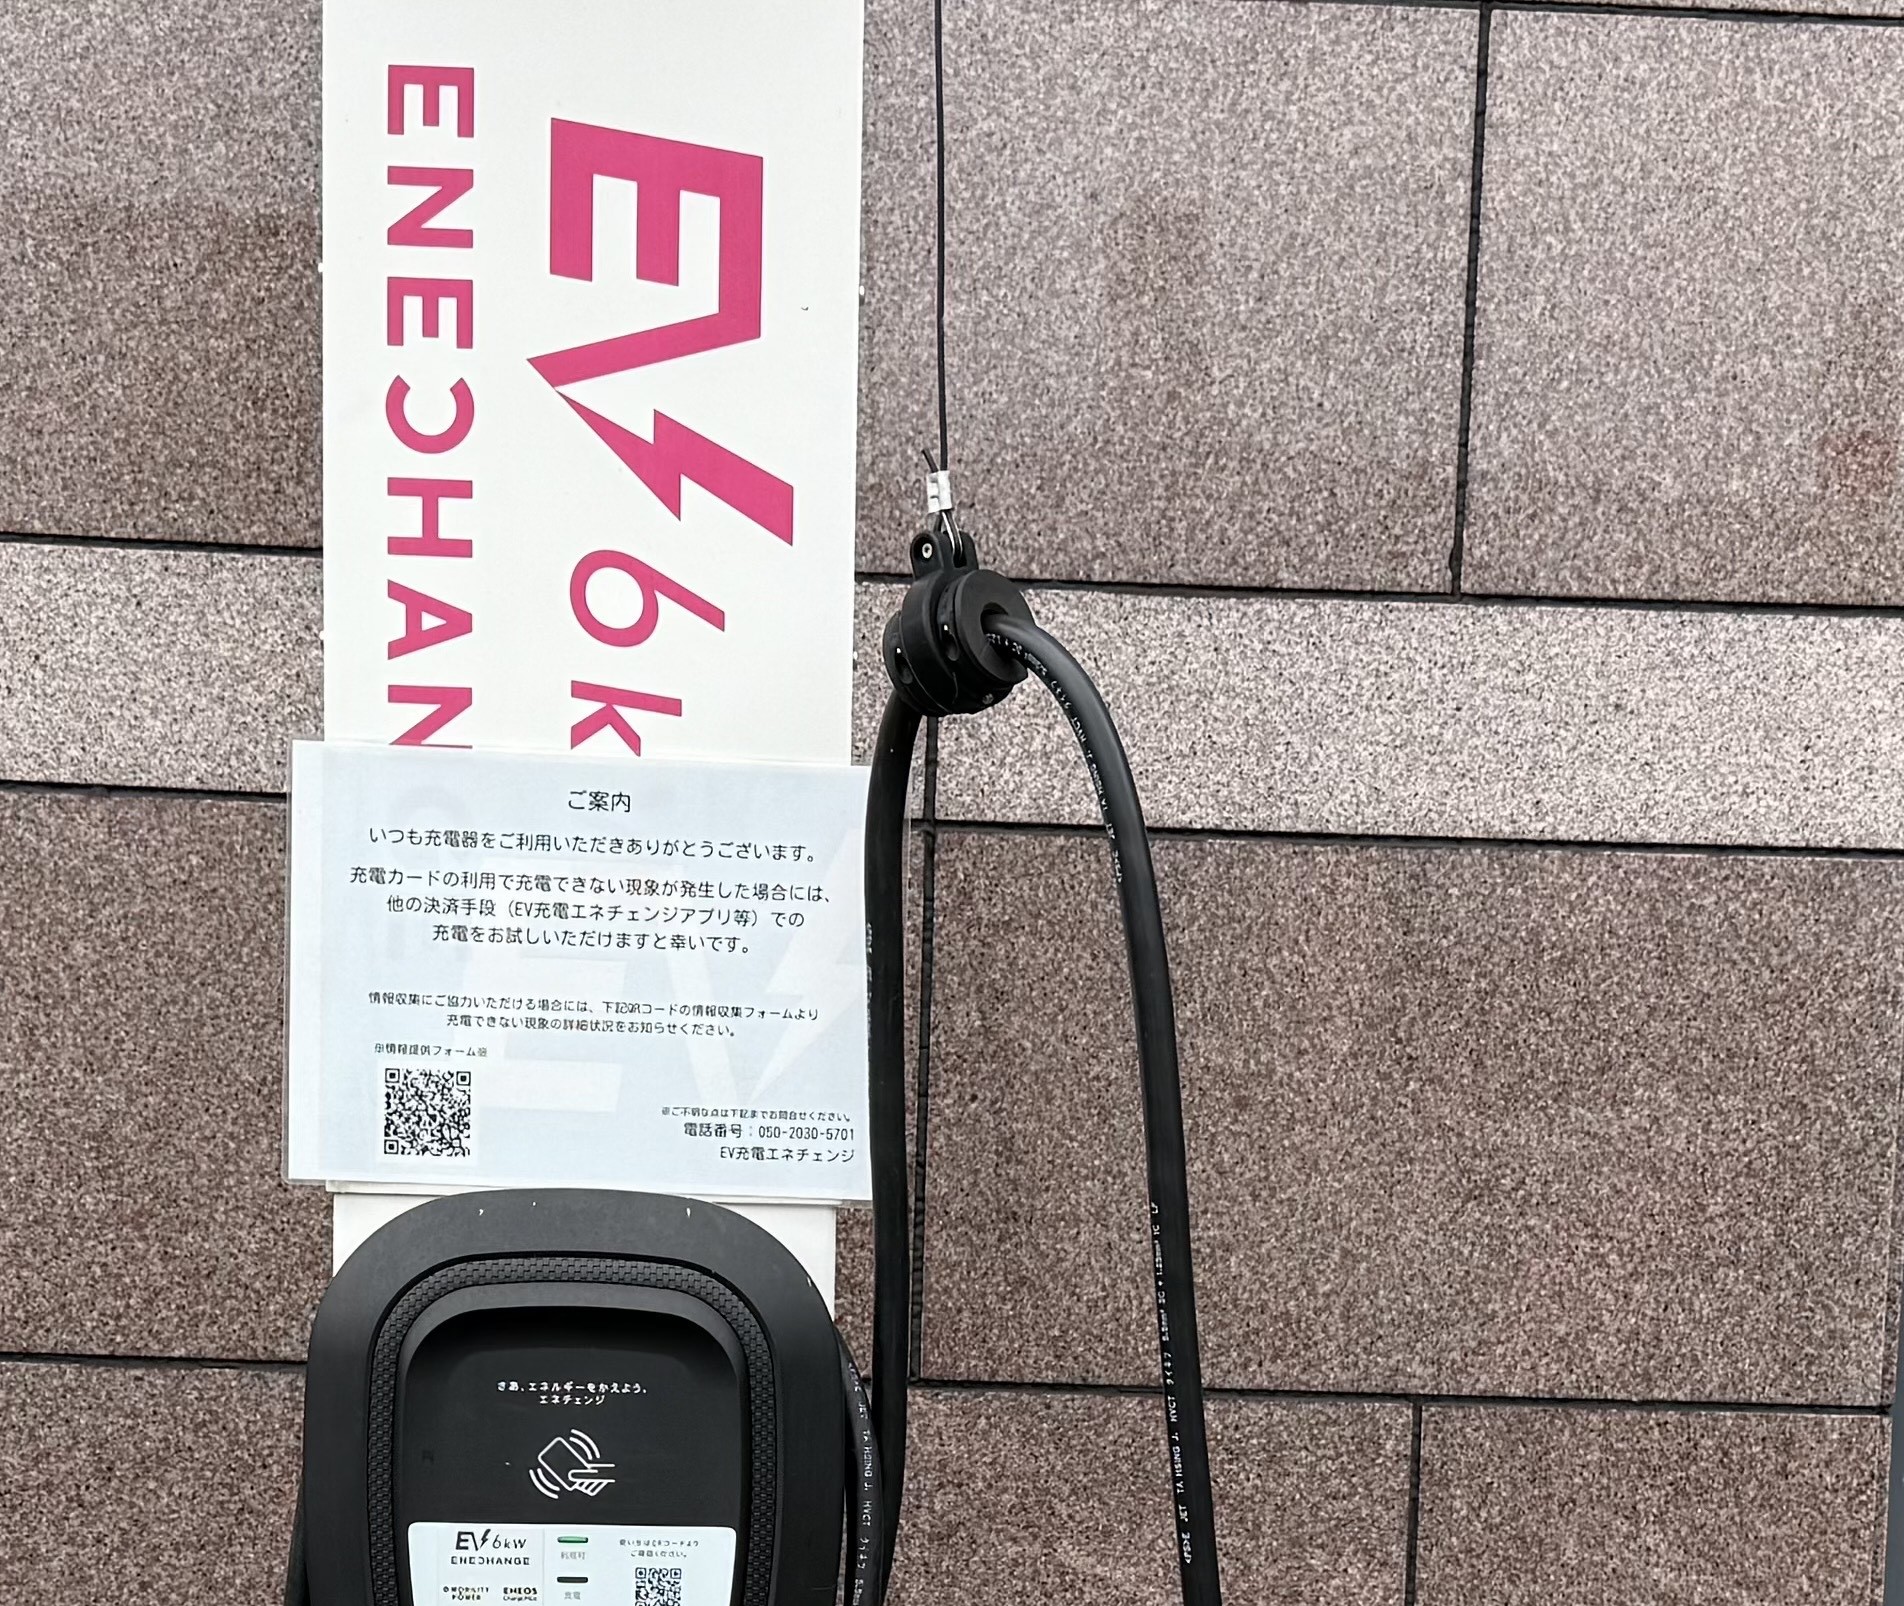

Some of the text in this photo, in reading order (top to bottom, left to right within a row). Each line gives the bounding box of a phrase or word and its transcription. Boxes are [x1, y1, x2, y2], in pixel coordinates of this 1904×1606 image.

[568, 790, 631, 813] ご案内
[369, 827, 815, 863] いつも充電器をご利用いただきありがとうございます。
[349, 866, 830, 903] 充電カードの利用で充電できない現象が発生した場合には、
[432, 924, 749, 954] 充電をお試しいただけますと幸いです。
[720, 1146, 855, 1163] EV充電エネチェンジ
[539, 1394, 605, 1405] エネチェンジ
